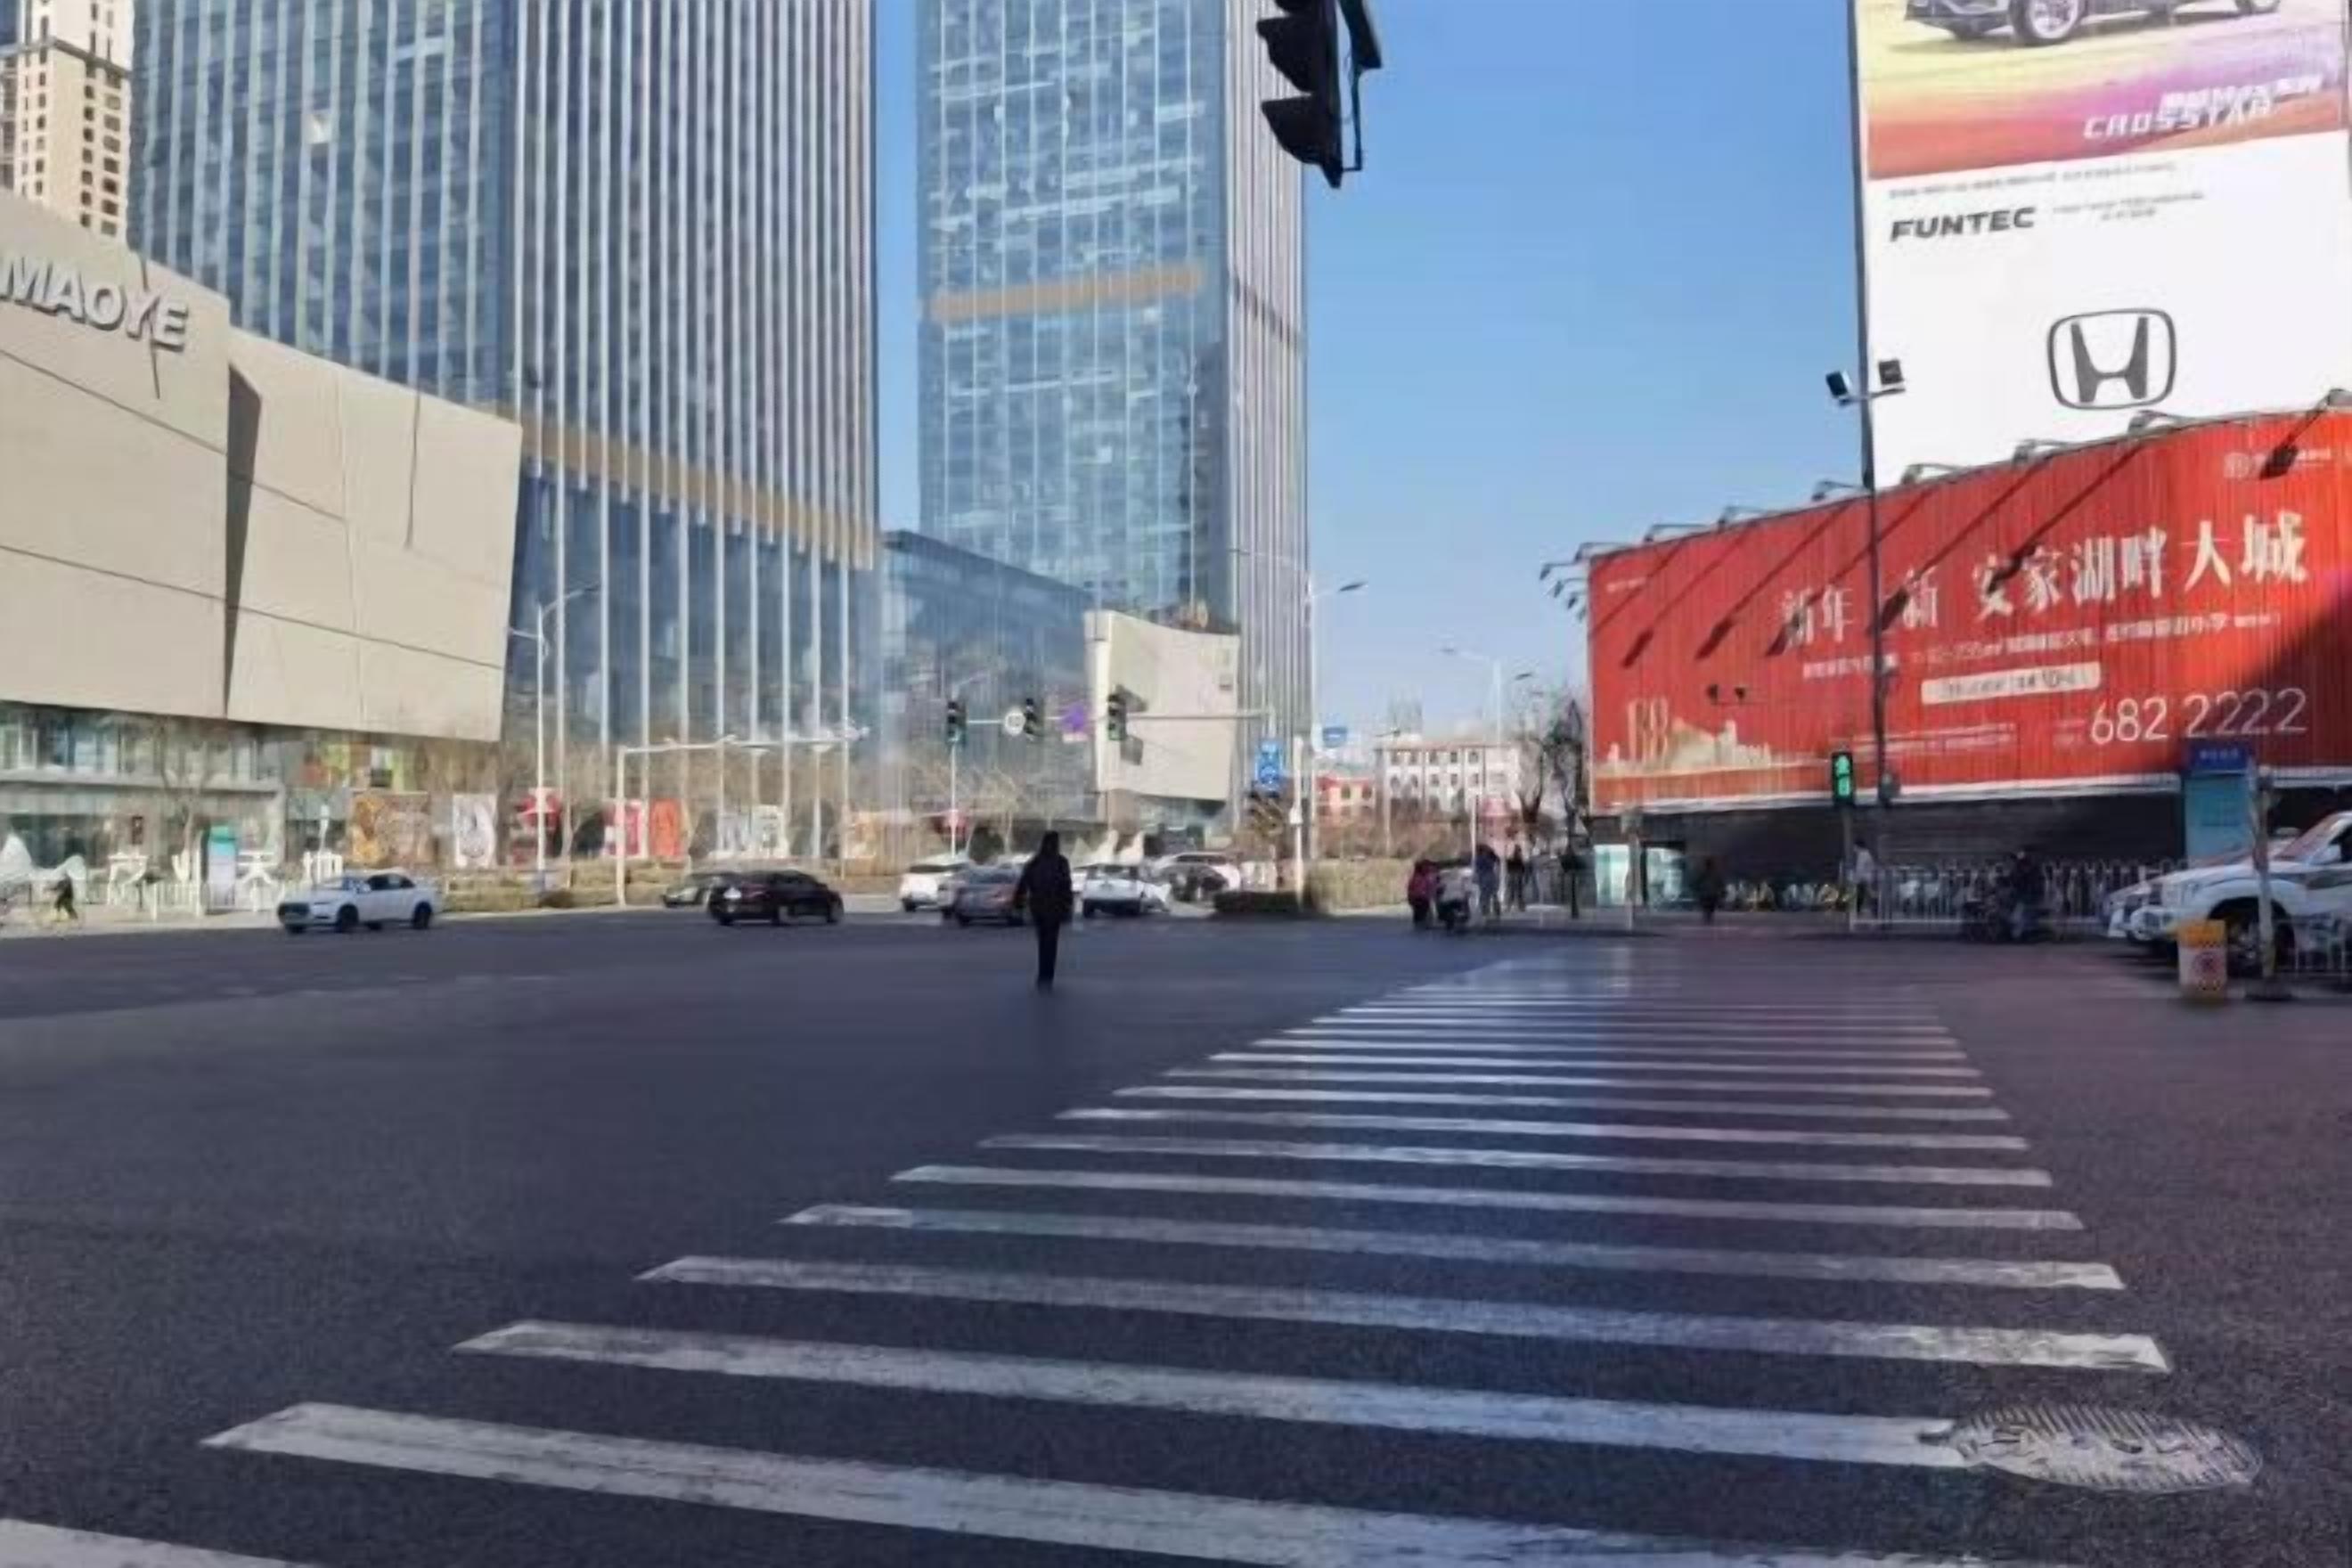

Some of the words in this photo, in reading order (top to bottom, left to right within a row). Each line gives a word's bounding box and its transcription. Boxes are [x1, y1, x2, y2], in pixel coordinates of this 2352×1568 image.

[1890, 207, 2037, 241] FUNTEC
[0, 256, 189, 353] MAOYE
[2090, 696, 2168, 745] 682
[2184, 687, 2307, 739] 2222
